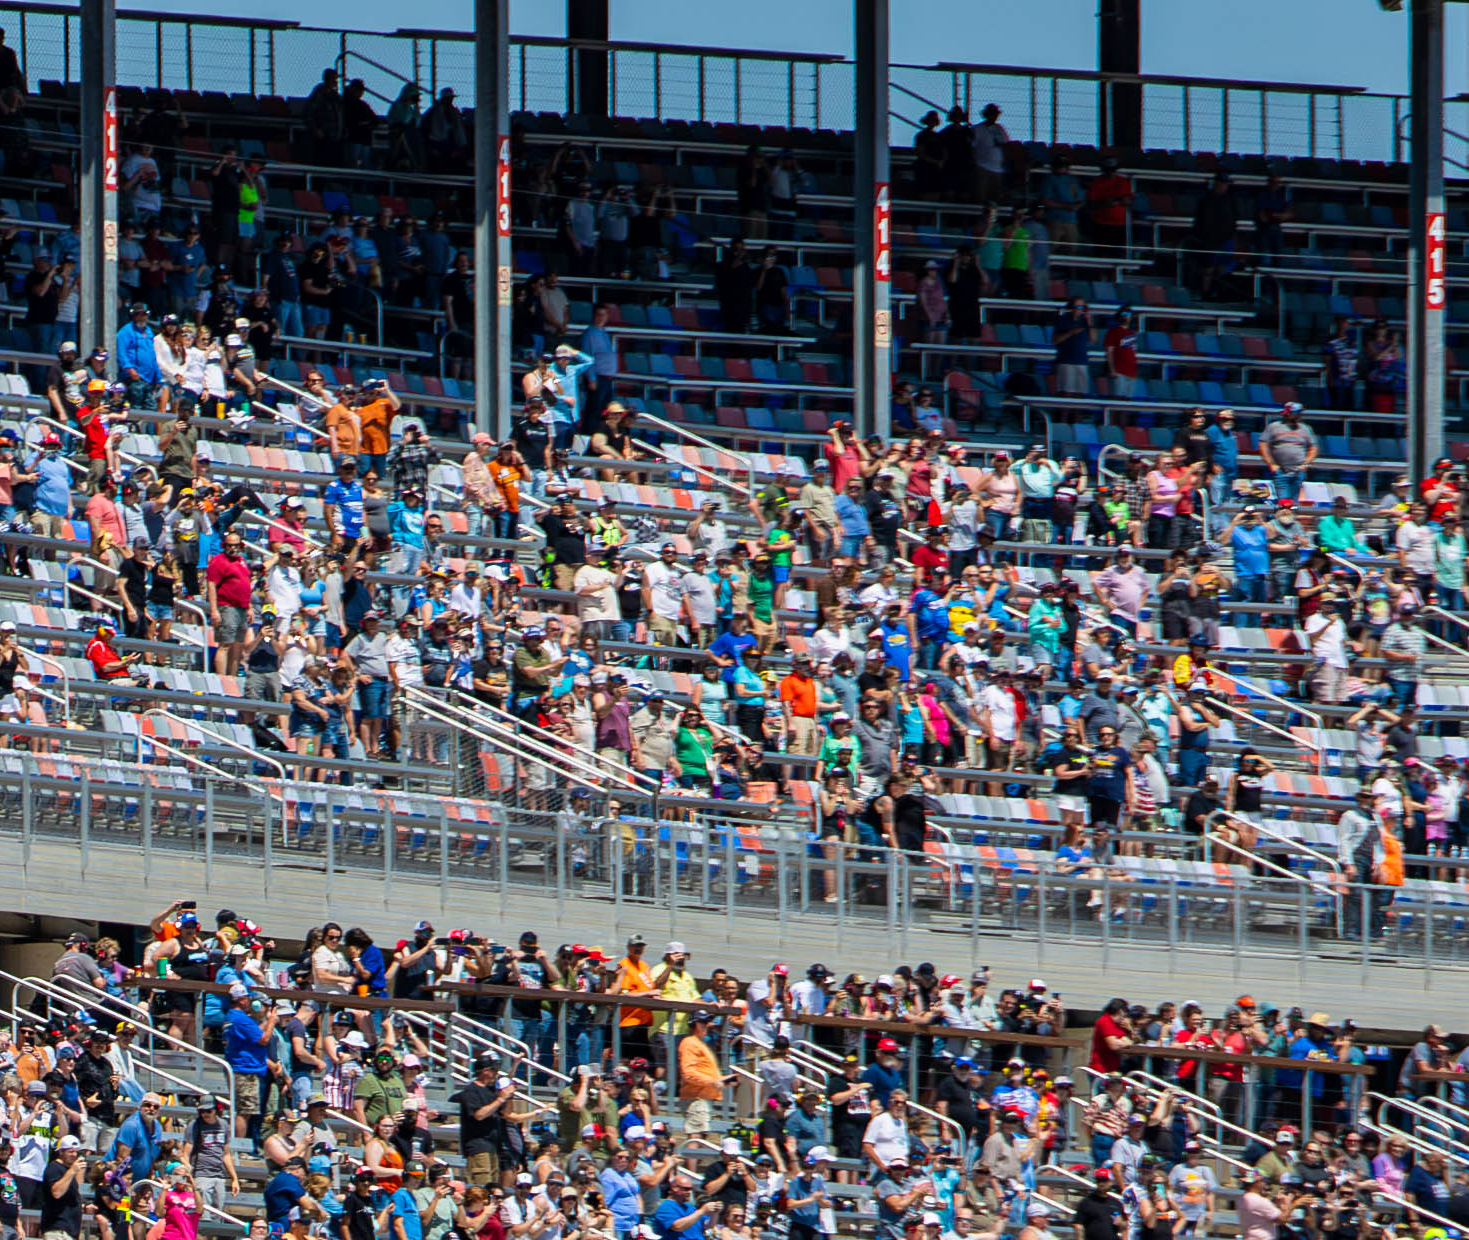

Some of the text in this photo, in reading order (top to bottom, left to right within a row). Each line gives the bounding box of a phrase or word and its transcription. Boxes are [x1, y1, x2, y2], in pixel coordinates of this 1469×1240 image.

[105, 90, 118, 185] 412
[498, 138, 510, 231] 413
[876, 185, 890, 276] 414
[1427, 215, 1445, 305] 415
